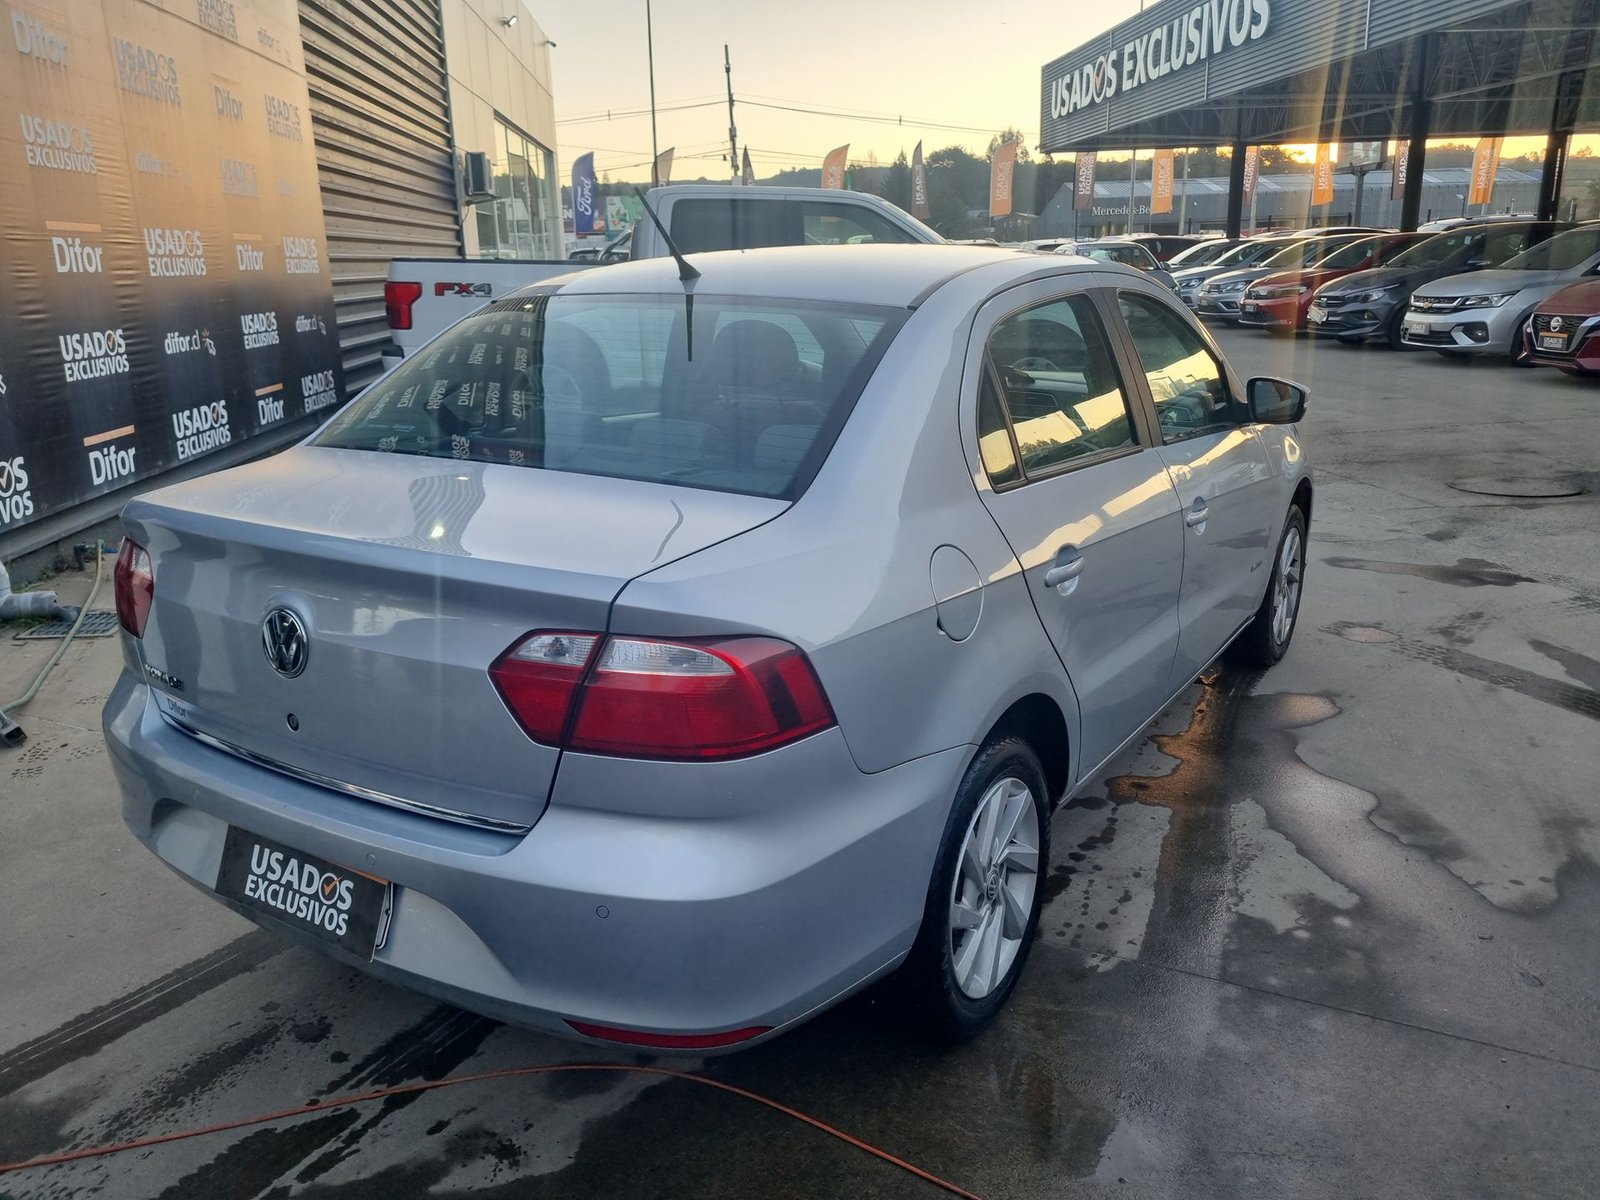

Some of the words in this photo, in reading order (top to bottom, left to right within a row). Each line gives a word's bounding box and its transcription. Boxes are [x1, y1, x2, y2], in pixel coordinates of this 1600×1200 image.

[112, 35, 178, 85] USADOS
[1052, 50, 1118, 119] USADOS
[1122, 0, 1270, 92] EXCLUSIVOS
[213, 85, 244, 120] Difor
[20, 114, 95, 154] USADOS
[25, 144, 97, 174] EXCLUSIVOS
[576, 176, 593, 216] Ford
[1092, 204, 1151, 217] Mercedes-Be
[52, 236, 103, 273] Difor
[143, 227, 204, 257] USADOS
[236, 244, 264, 271] Difor
[148, 256, 208, 278] EXCLUSIVOS
[434, 282, 493, 297] FX4
[240, 311, 278, 335] USADOS
[58, 328, 127, 362] USADOS
[164, 328, 201, 355] difor.cl
[63, 353, 130, 383] EXCLUSIVOS
[301, 369, 336, 398] USADOS
[172, 399, 229, 439] USADOS
[257, 397, 284, 425] Difor
[176, 424, 233, 460] EXCLUSIVOS
[89, 444, 136, 487] Difor
[251, 843, 355, 911] USADOS
[243, 873, 349, 936] EXCLUSIVOS
